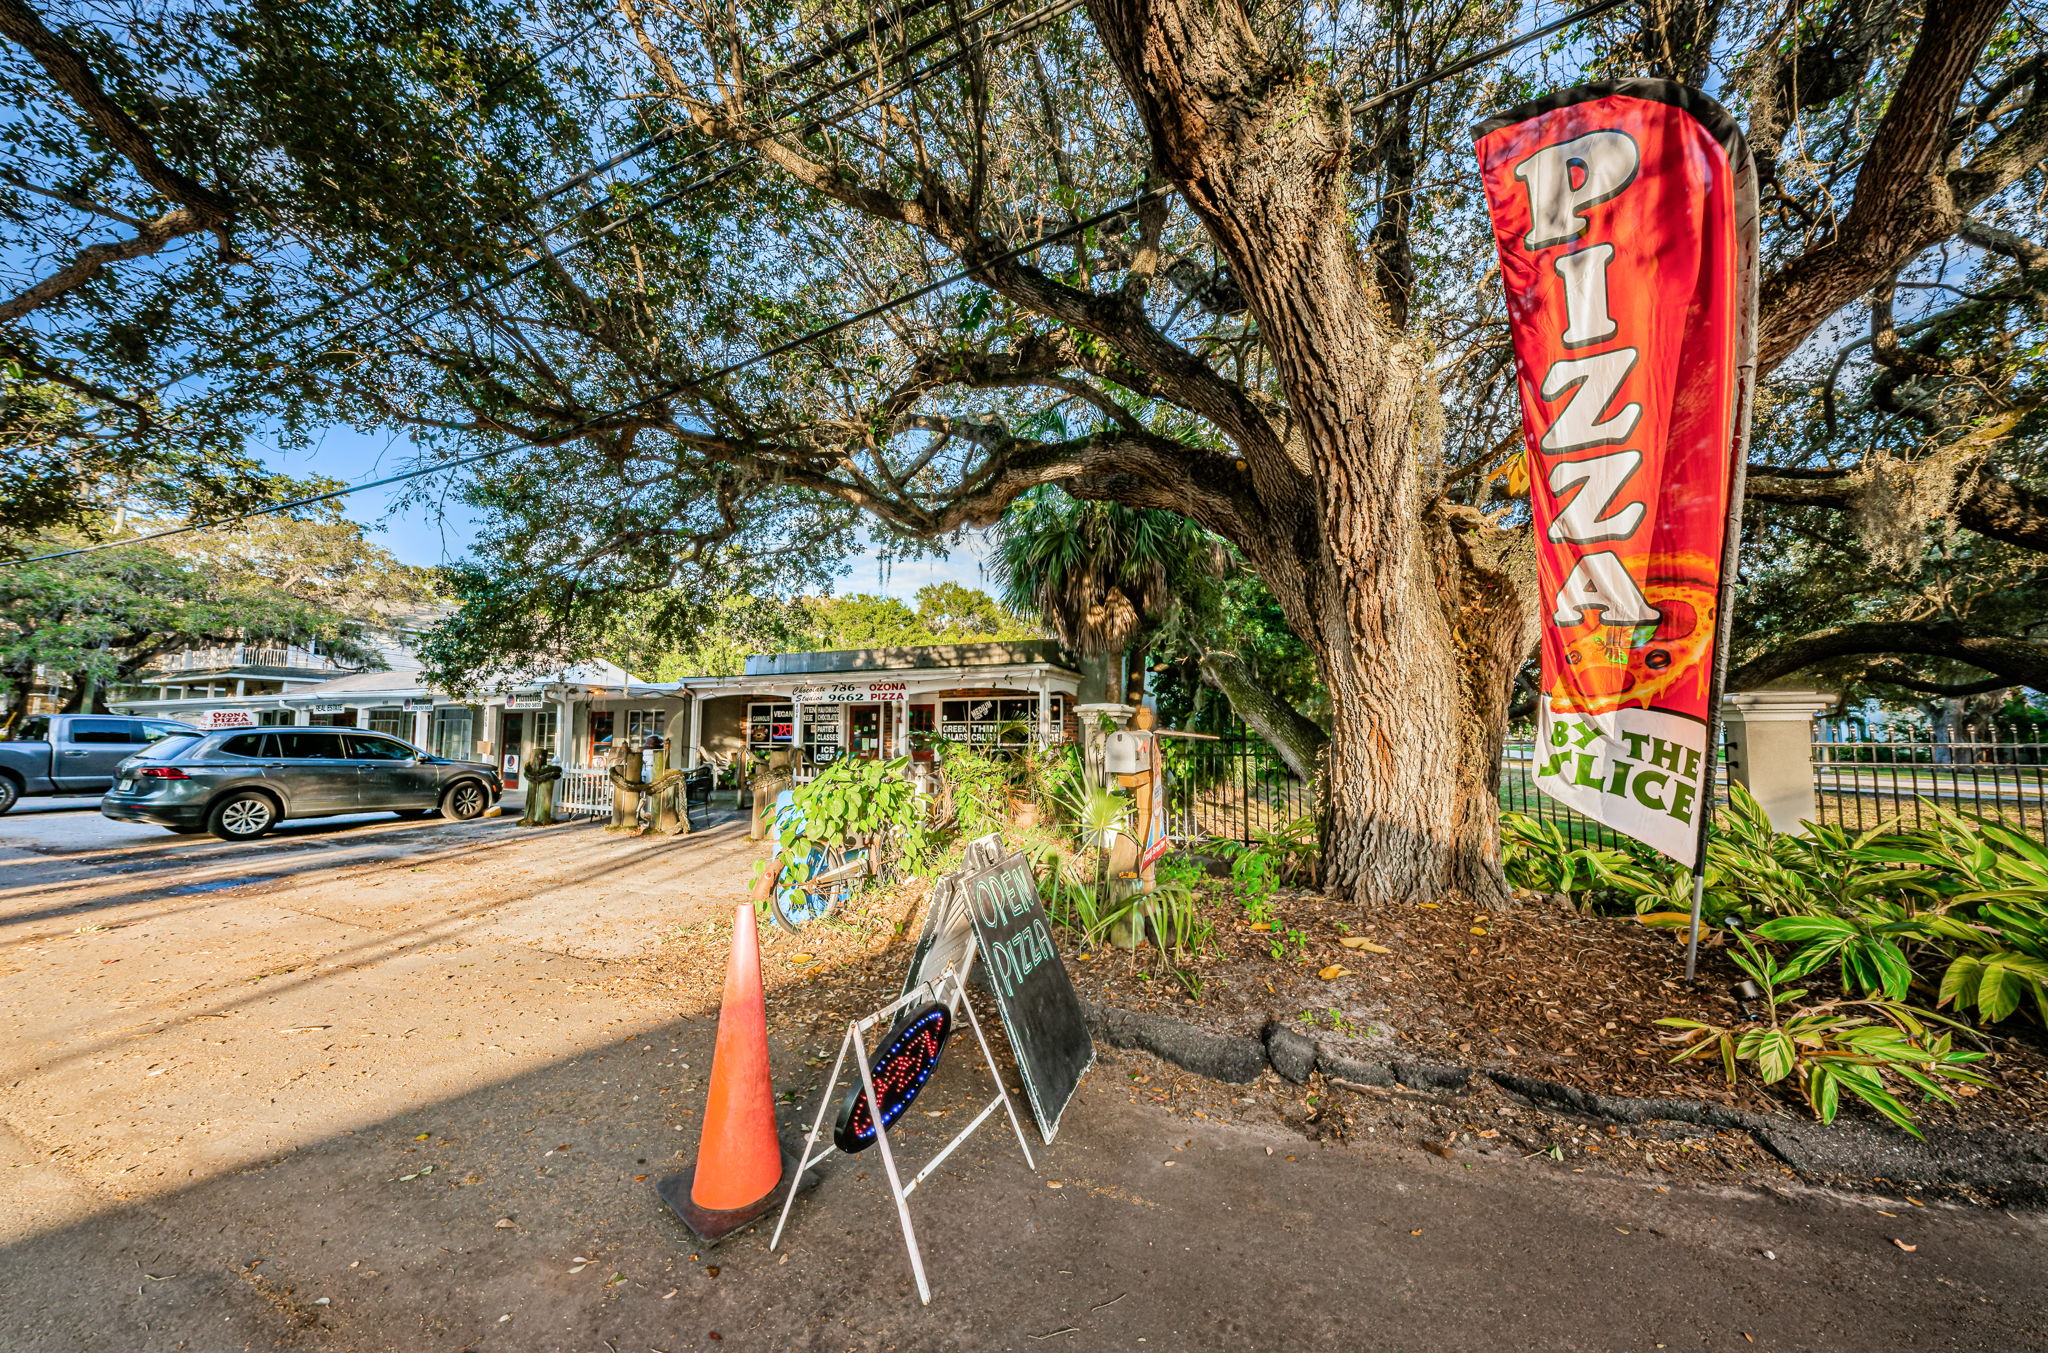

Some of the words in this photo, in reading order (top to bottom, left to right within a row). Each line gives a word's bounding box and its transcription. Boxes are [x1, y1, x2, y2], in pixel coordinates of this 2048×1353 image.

[1513, 127, 1664, 628] PIZZA
[792, 686, 826, 696] Chocolate
[868, 682, 907, 691] OZONA
[515, 694, 542, 702] Plumbing
[795, 694, 823, 702] Studios
[828, 693, 864, 702] 9662
[870, 692, 905, 701] PIZZA
[327, 703, 343, 711] ESTATE
[774, 710, 794, 718] VEGAN
[943, 724, 967, 733] GREEK
[971, 724, 997, 733] THIN
[817, 733, 839, 741] CLASSES
[943, 733, 968, 742] SALADS
[1551, 720, 1607, 750] BY
[1622, 729, 1702, 782] THE
[816, 753, 839, 761] CREA
[1538, 749, 1697, 827] SLICE
[975, 865, 1035, 929] OPEN
[991, 918, 1056, 998] PIZZA
